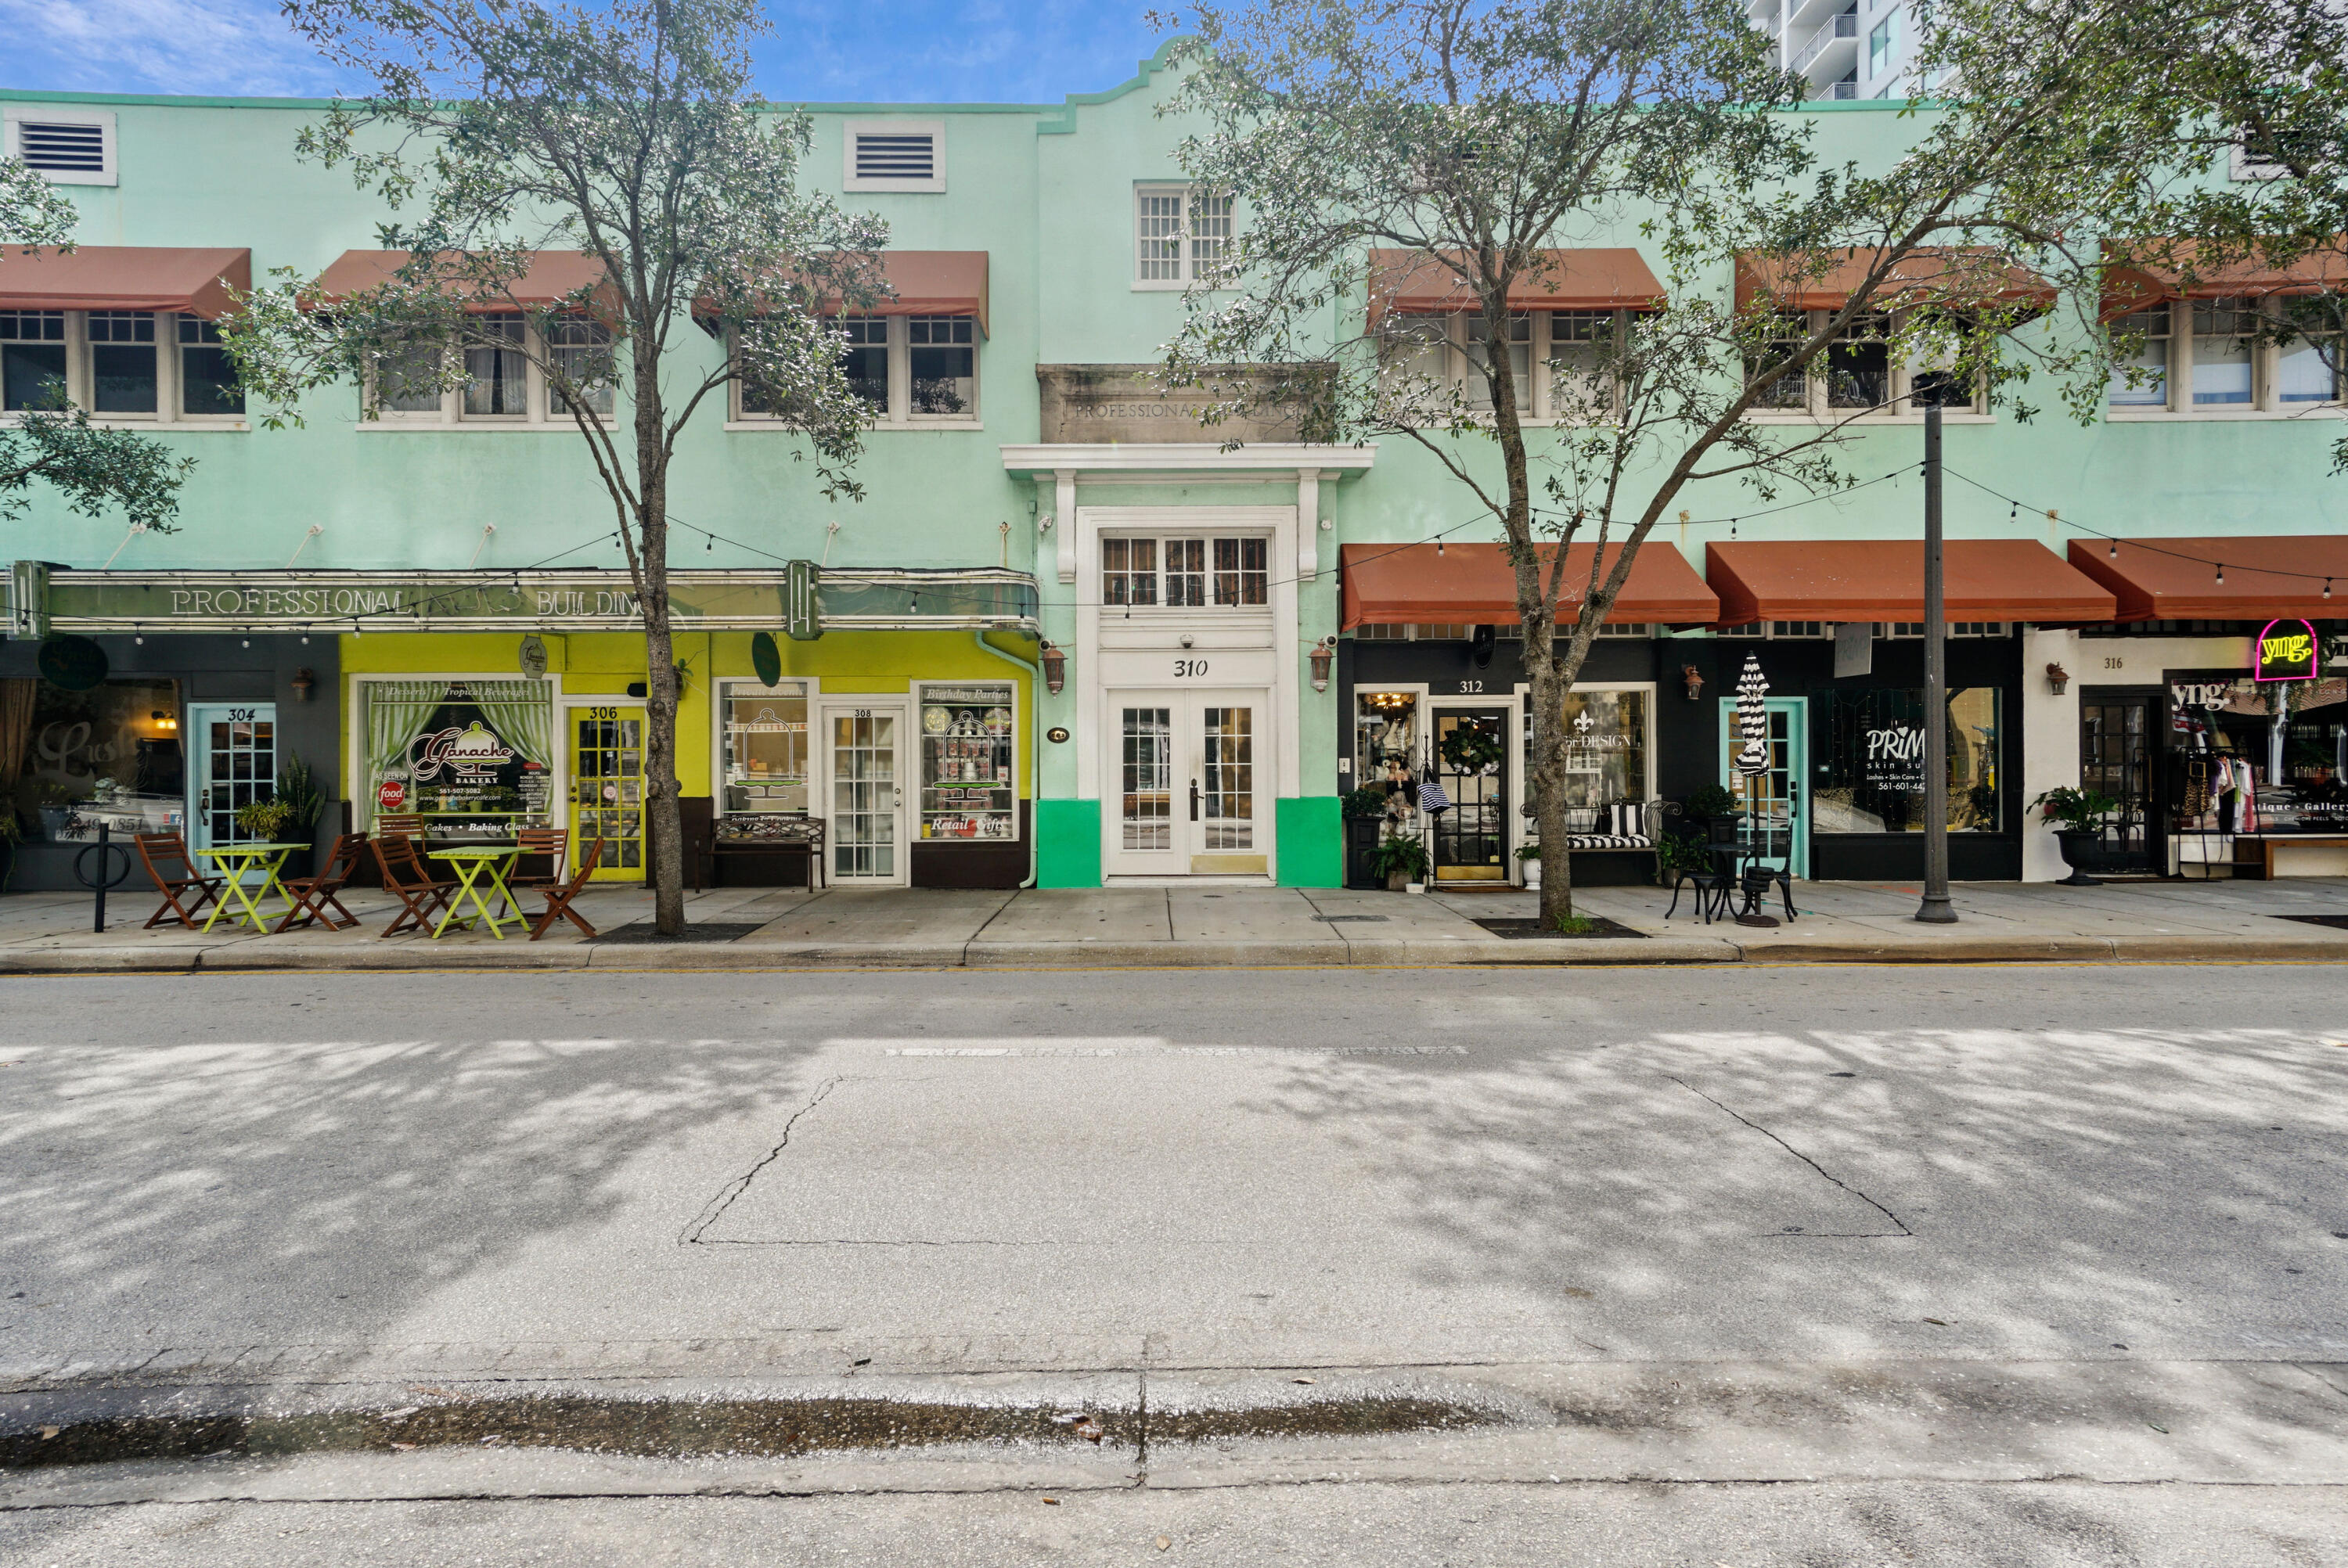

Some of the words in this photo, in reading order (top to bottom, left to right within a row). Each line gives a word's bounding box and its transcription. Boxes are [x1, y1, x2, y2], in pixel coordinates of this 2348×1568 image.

[170, 589, 411, 615] PROFESSIONAL
[1174, 660, 1208, 678] 310
[2105, 657, 2123, 669] 316
[389, 687, 427, 696] Desserts
[444, 687, 481, 698] Tropical
[484, 687, 530, 698] Beverages
[1460, 680, 1483, 693] 312
[927, 689, 971, 701] Birthday
[974, 689, 1009, 699] Parties
[2172, 683, 2231, 711] yng.
[228, 708, 255, 721] 304
[589, 707, 618, 719] 306
[855, 709, 871, 717] 308
[1582, 735, 1630, 747] DESIGN
[1866, 726, 1925, 760] PRiM
[406, 727, 515, 782] Ganache
[380, 787, 404, 802] food
[425, 823, 452, 832] Cakes
[468, 822, 502, 833] Baking
[504, 822, 530, 831] Class
[931, 818, 968, 831] Retail
[976, 818, 1004, 832] Gifts
